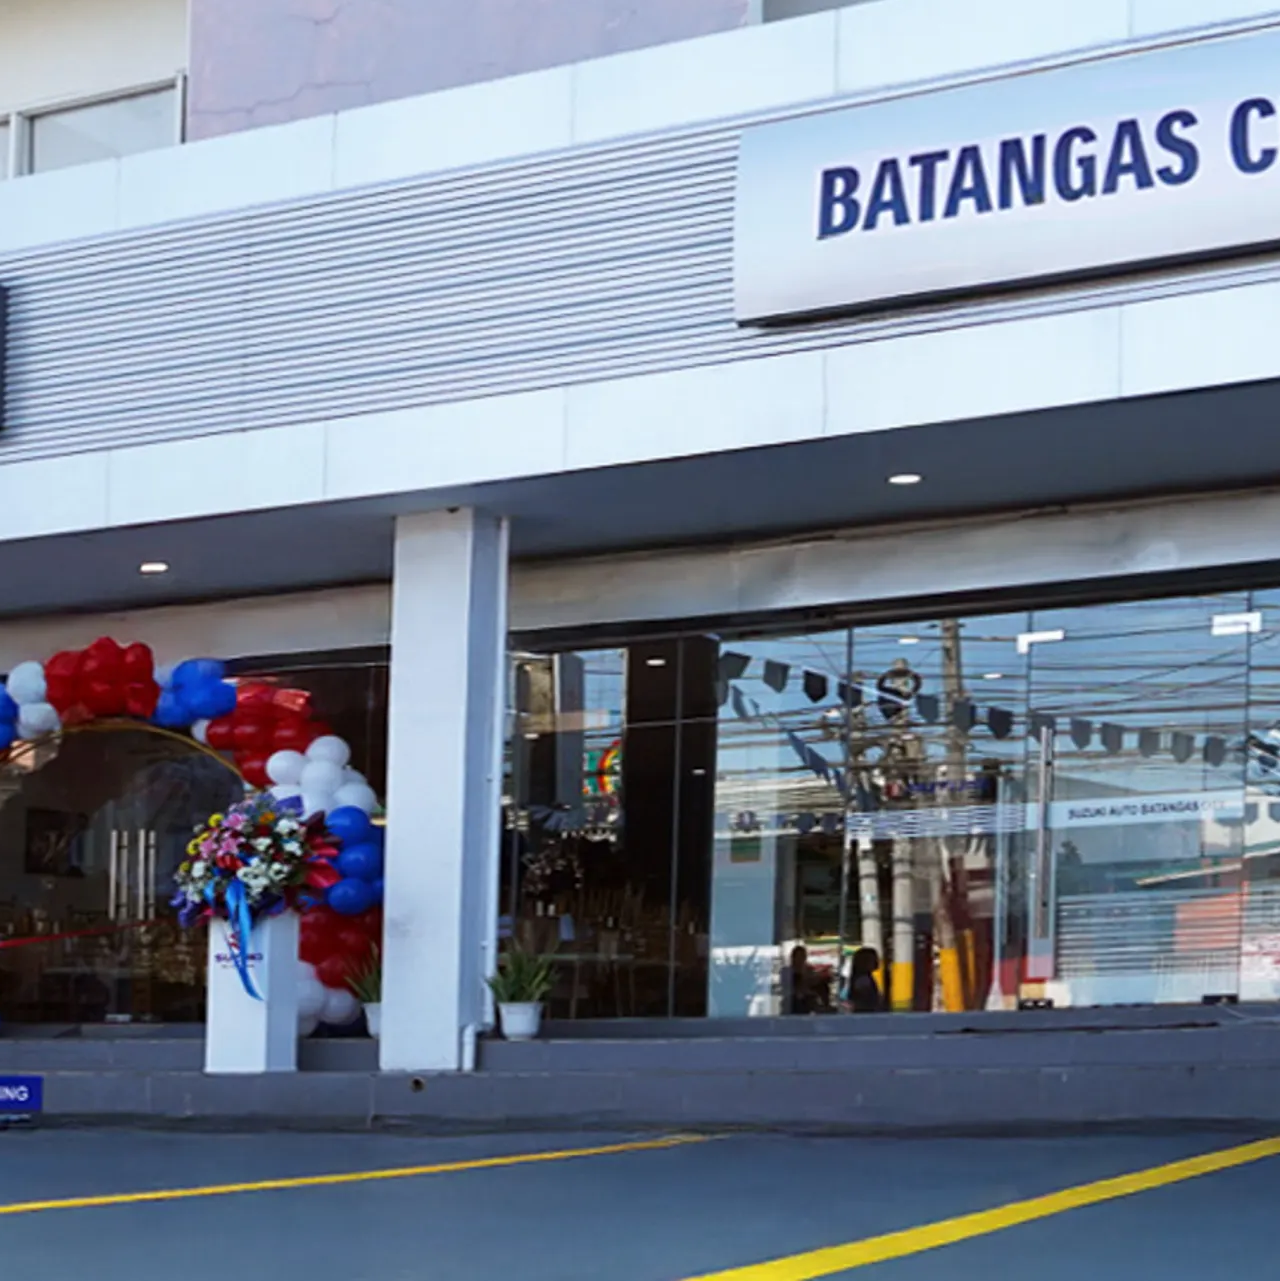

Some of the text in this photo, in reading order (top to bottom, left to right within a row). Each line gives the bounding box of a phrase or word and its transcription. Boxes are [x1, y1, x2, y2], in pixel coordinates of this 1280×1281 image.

[817, 109, 1199, 240] BATANGAS
[1068, 806, 1106, 820] SUZUKI
[1109, 804, 1138, 817] AUTO
[1141, 800, 1199, 816] BATANGAS
